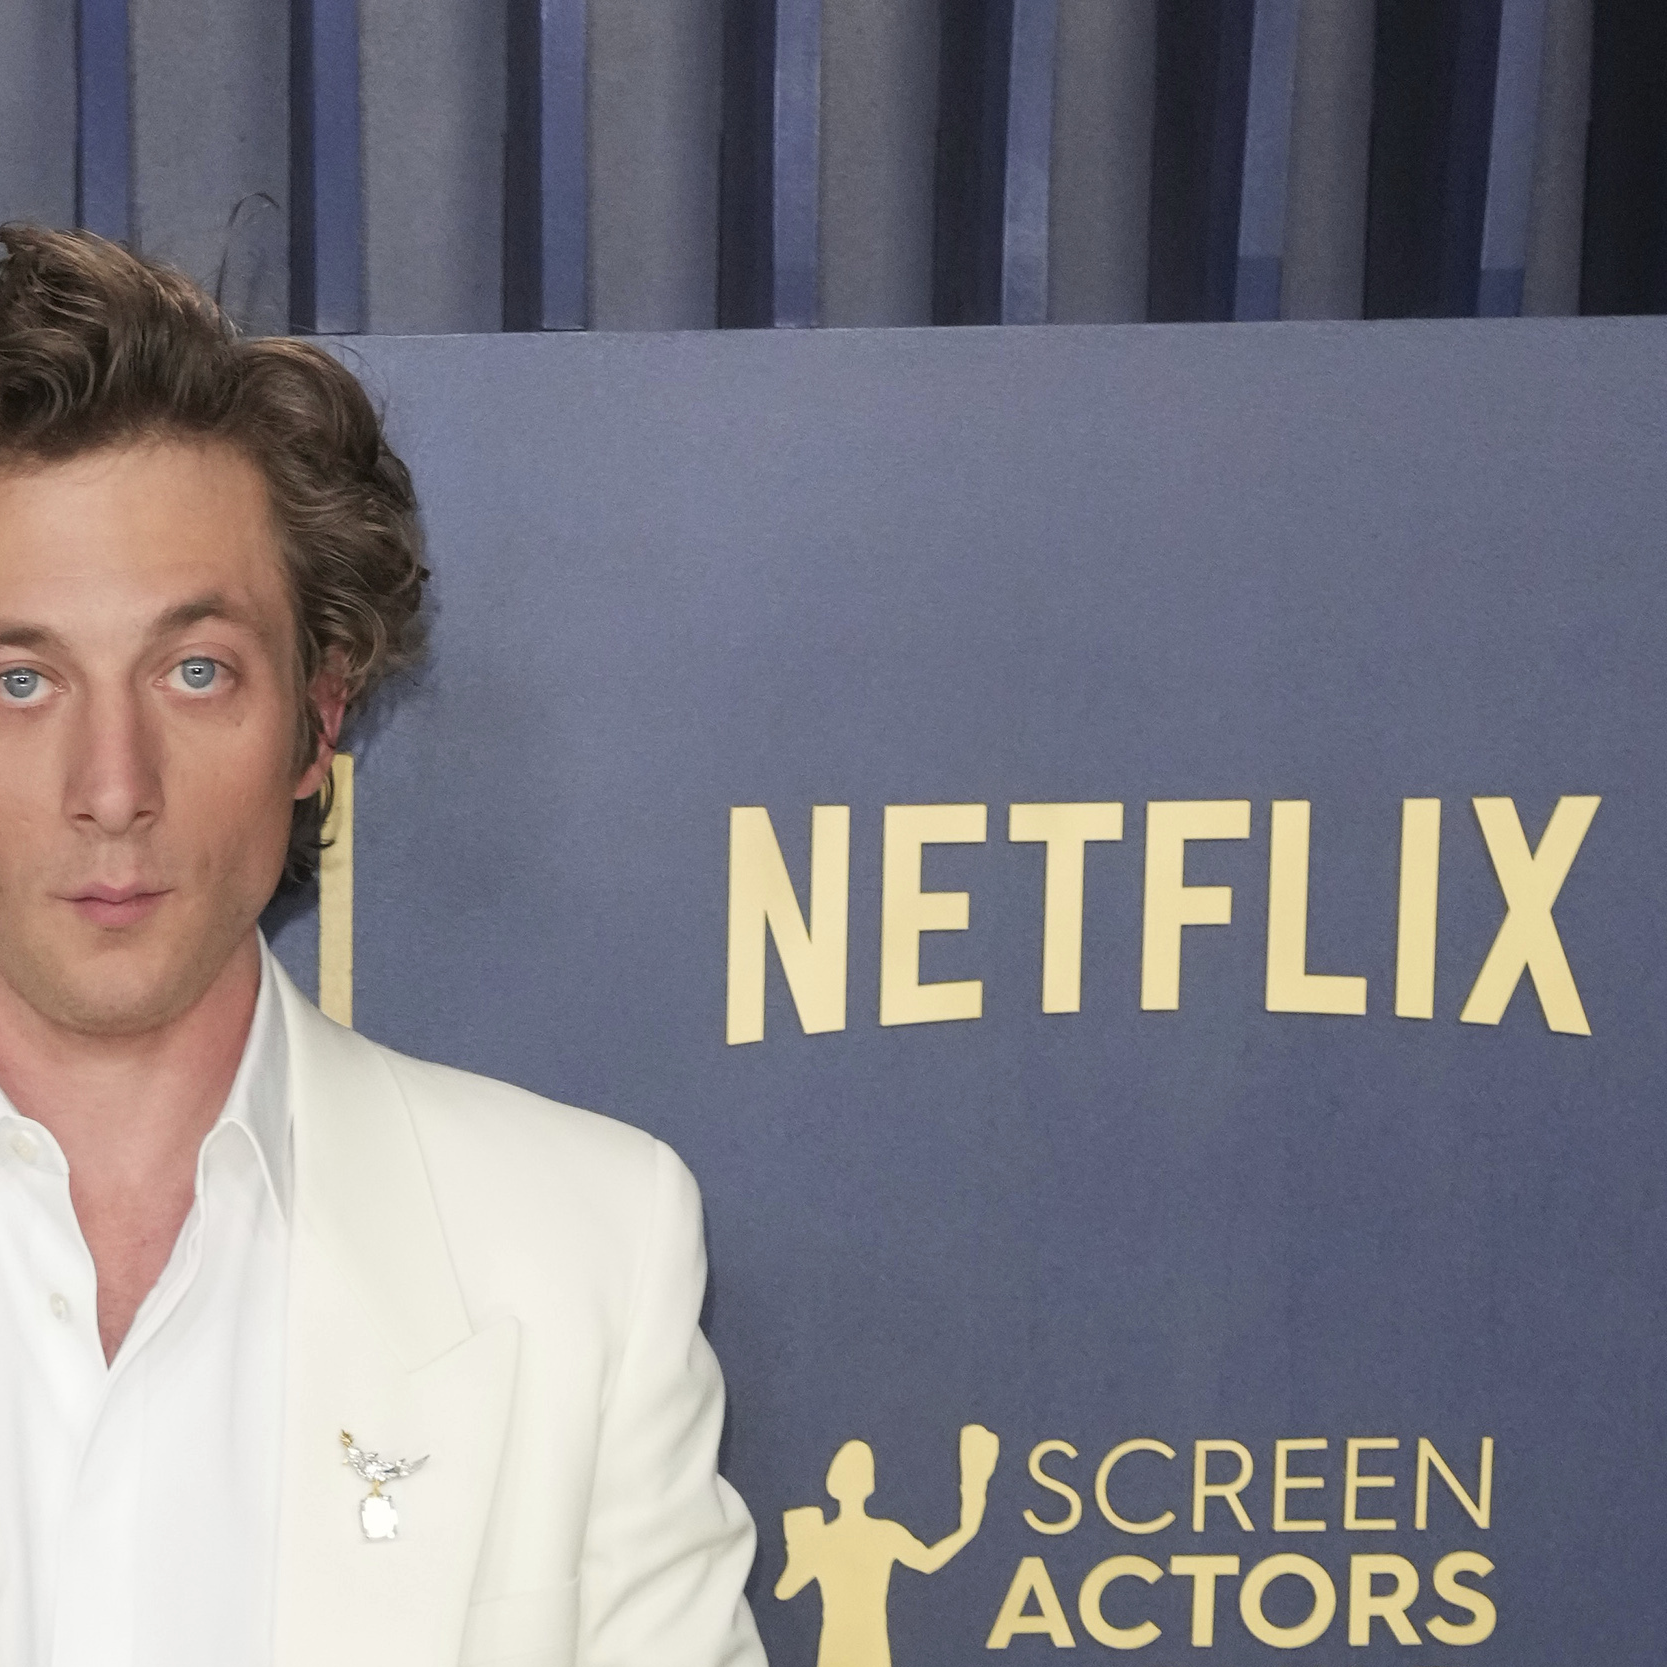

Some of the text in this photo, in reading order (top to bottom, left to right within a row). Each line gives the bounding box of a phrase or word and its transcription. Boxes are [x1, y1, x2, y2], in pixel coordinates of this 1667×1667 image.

[725, 795, 1603, 1047] NETFLIX
[1022, 1435, 1495, 1536] SCREEN
[985, 1550, 1499, 1651] ACTORS
